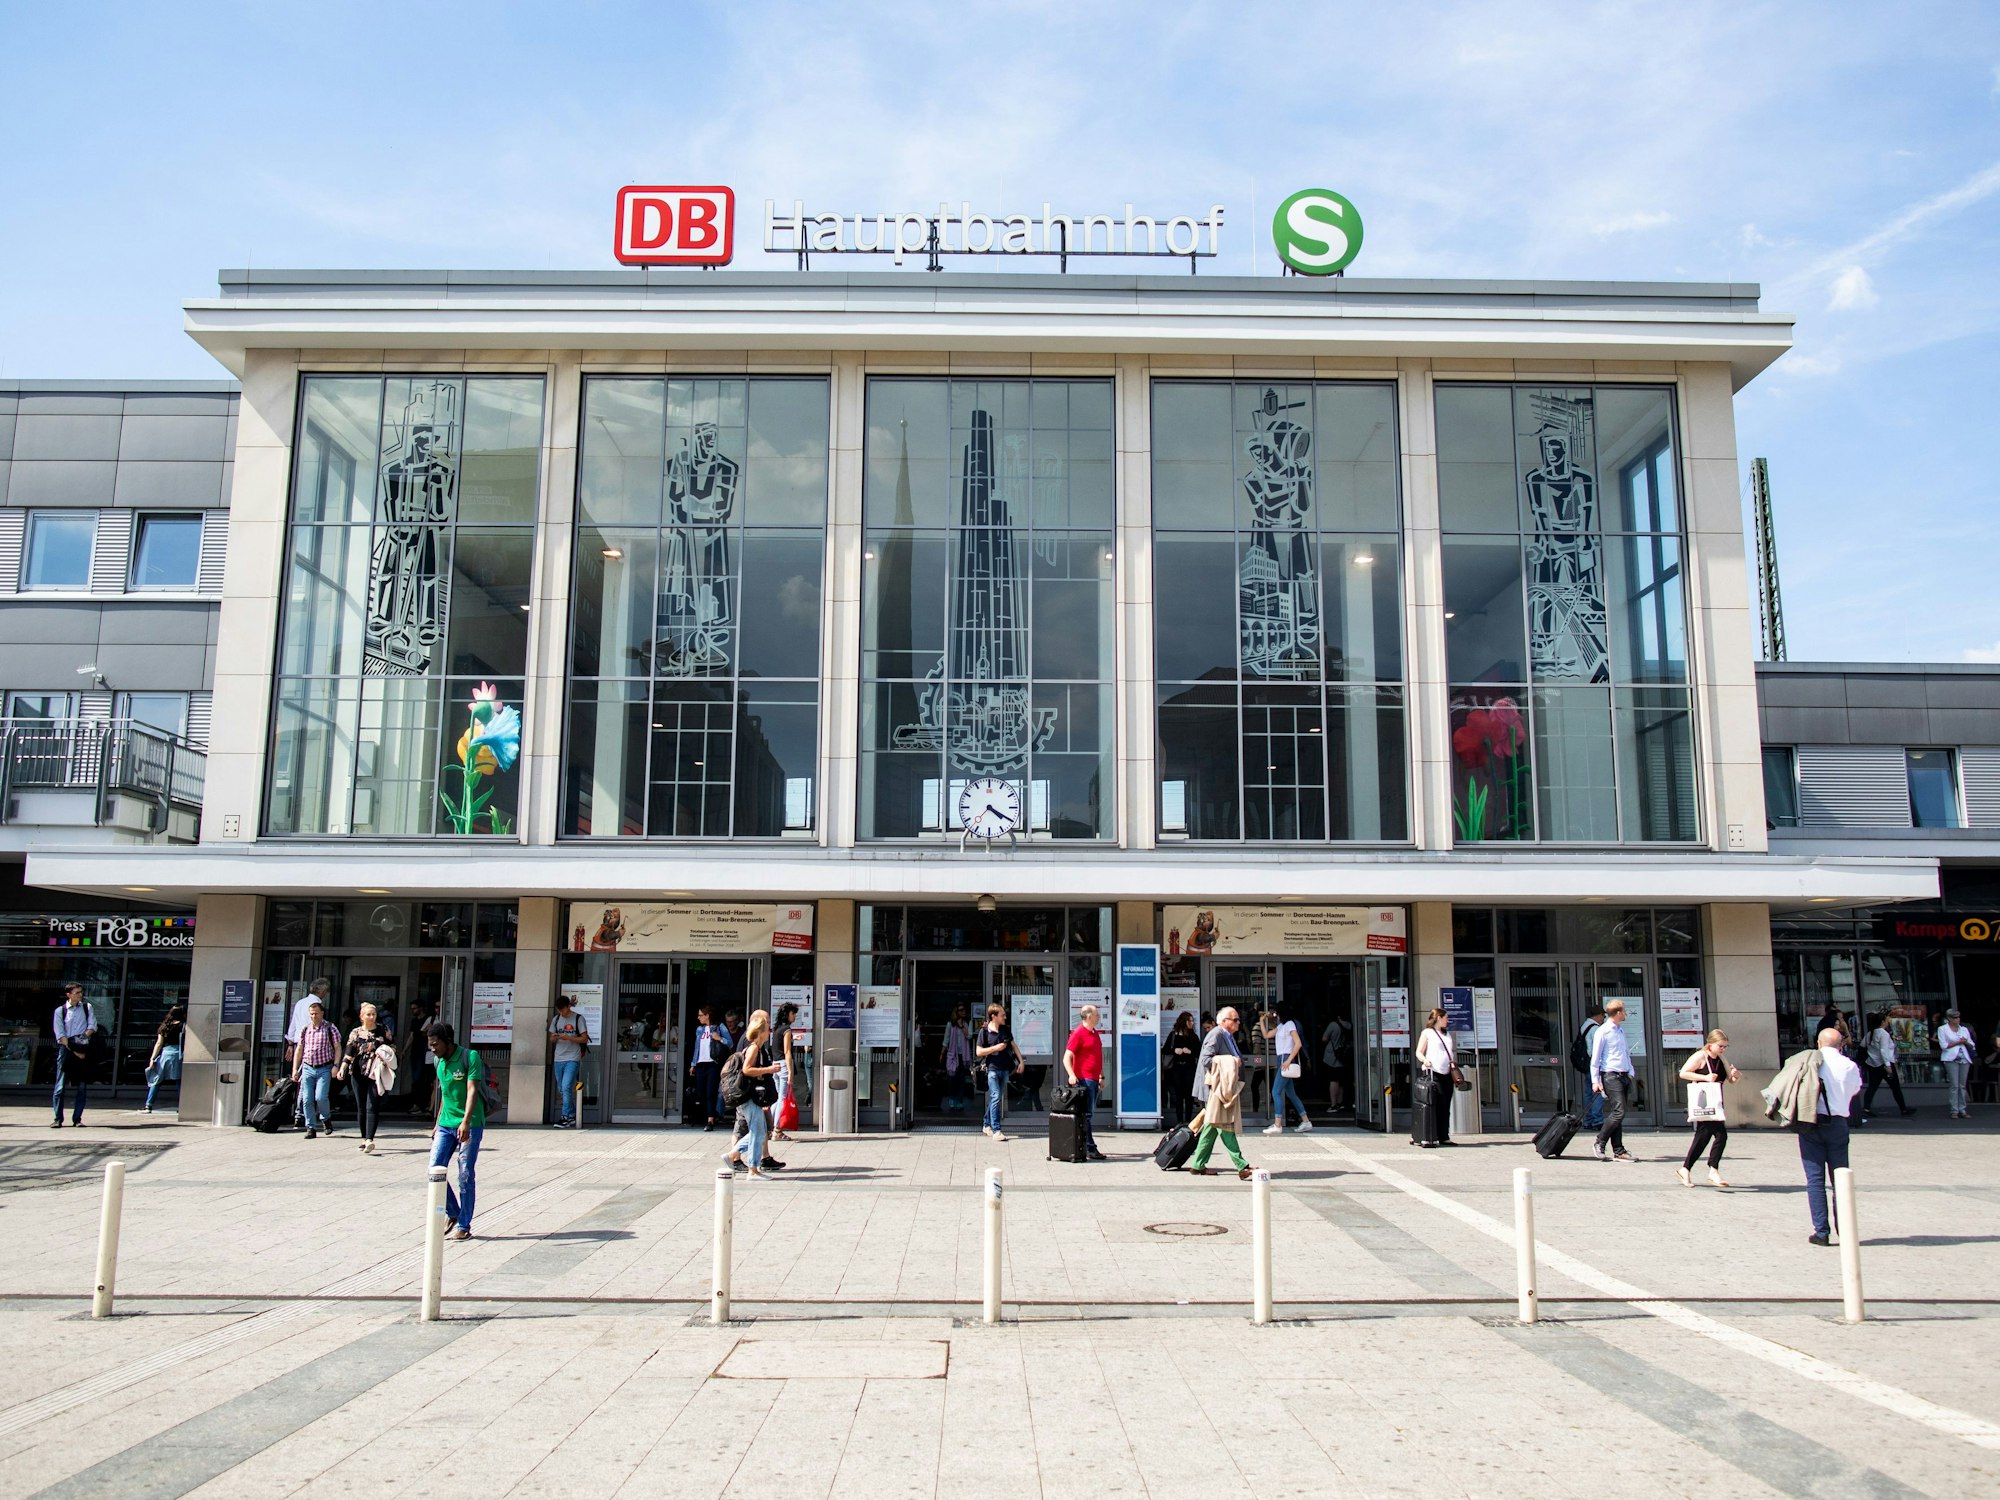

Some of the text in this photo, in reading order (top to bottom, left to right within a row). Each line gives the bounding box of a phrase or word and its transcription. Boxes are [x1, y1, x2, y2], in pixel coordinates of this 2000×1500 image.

[629, 198, 719, 250] DB
[763, 199, 1225, 266] Hauptbahnhof
[1286, 196, 1348, 266] S
[717, 916, 767, 924] Bau-Brennpunkt.
[789, 911, 801, 919] DB
[1310, 919, 1360, 927] Bau-Brennpunkt.
[1381, 913, 1393, 921] DB
[50, 918, 194, 947] Press P&B Books
[1895, 921, 1957, 940] Kamps
